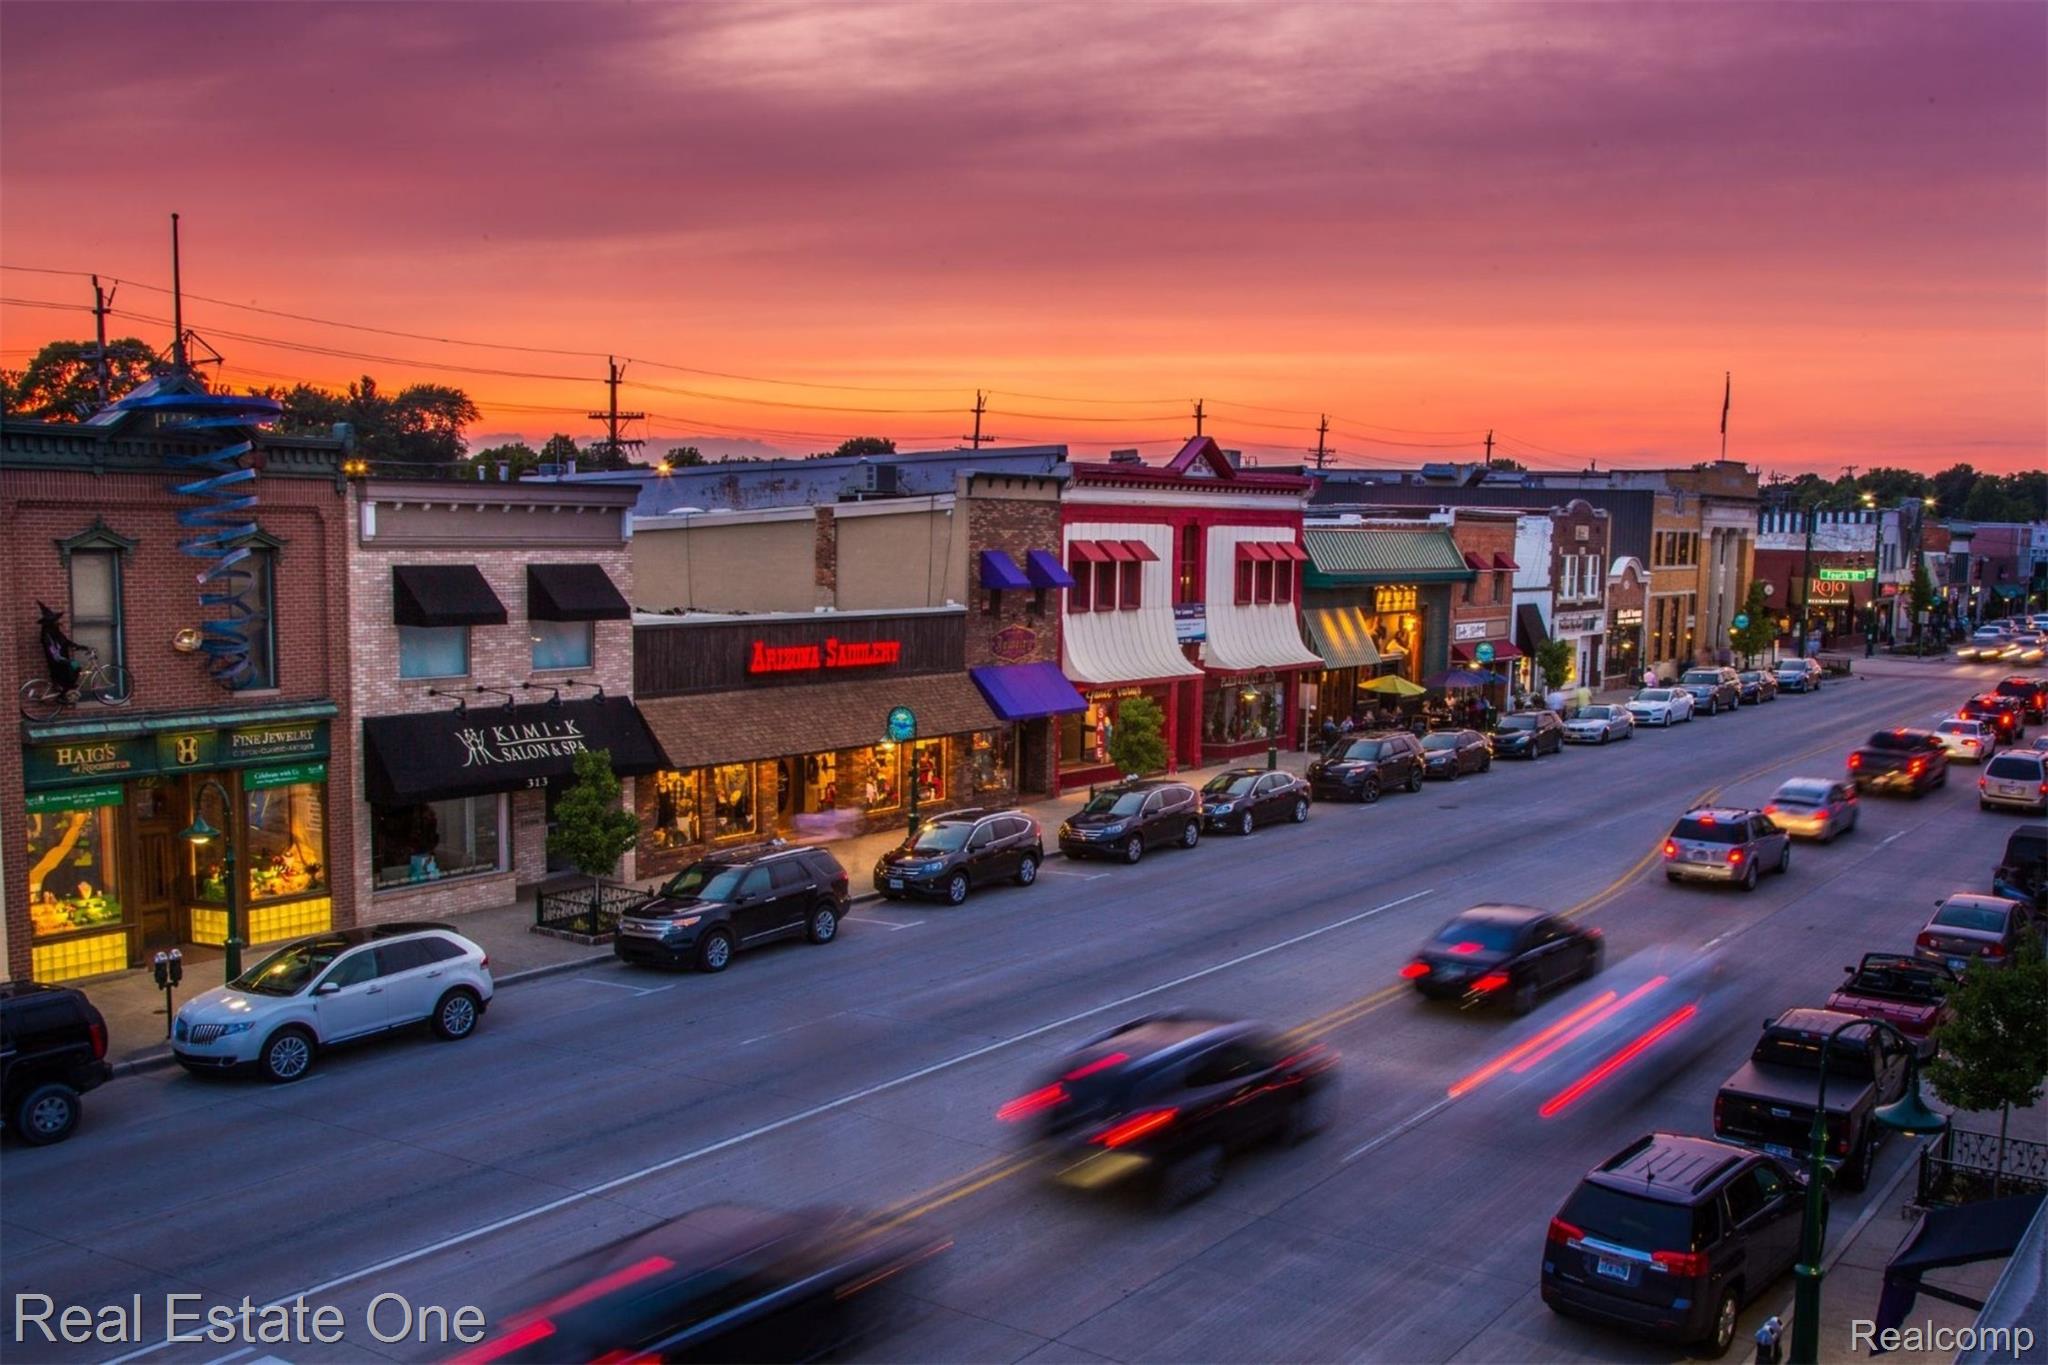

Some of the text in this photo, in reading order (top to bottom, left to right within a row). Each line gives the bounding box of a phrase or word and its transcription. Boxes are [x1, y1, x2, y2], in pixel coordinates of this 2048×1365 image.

[750, 636, 900, 673] ARIZONA SADDLERY
[232, 729, 314, 747] FINE JEWELRY
[1097, 707, 1105, 758] SALE
[56, 743, 115, 765] HAIG'S
[501, 740, 588, 762] SALON & SPA
[527, 777, 548, 788] 313
